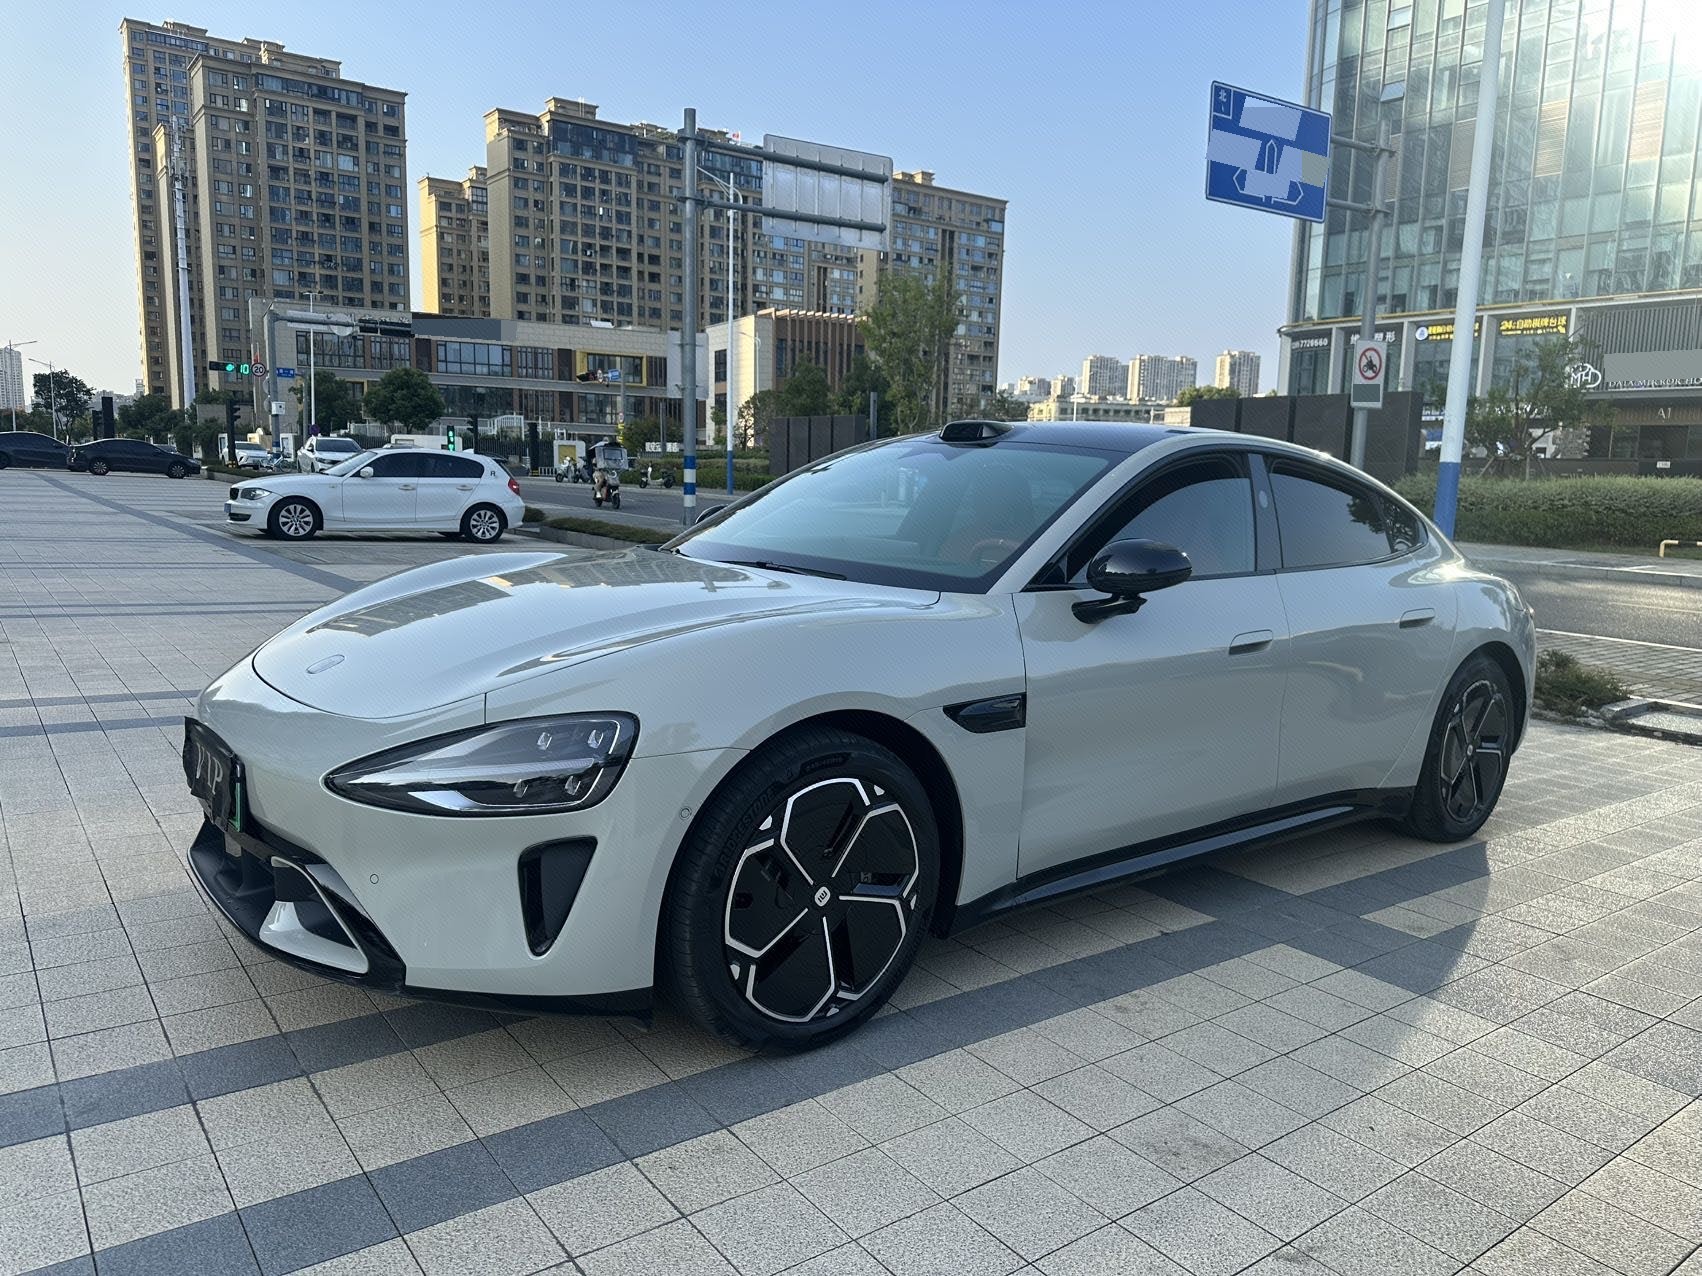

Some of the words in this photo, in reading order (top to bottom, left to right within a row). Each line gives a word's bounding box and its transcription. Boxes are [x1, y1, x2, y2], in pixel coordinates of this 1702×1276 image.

[1218, 89, 1227, 102] 北
[240, 363, 250, 376] 10
[254, 366, 263, 374] 20
